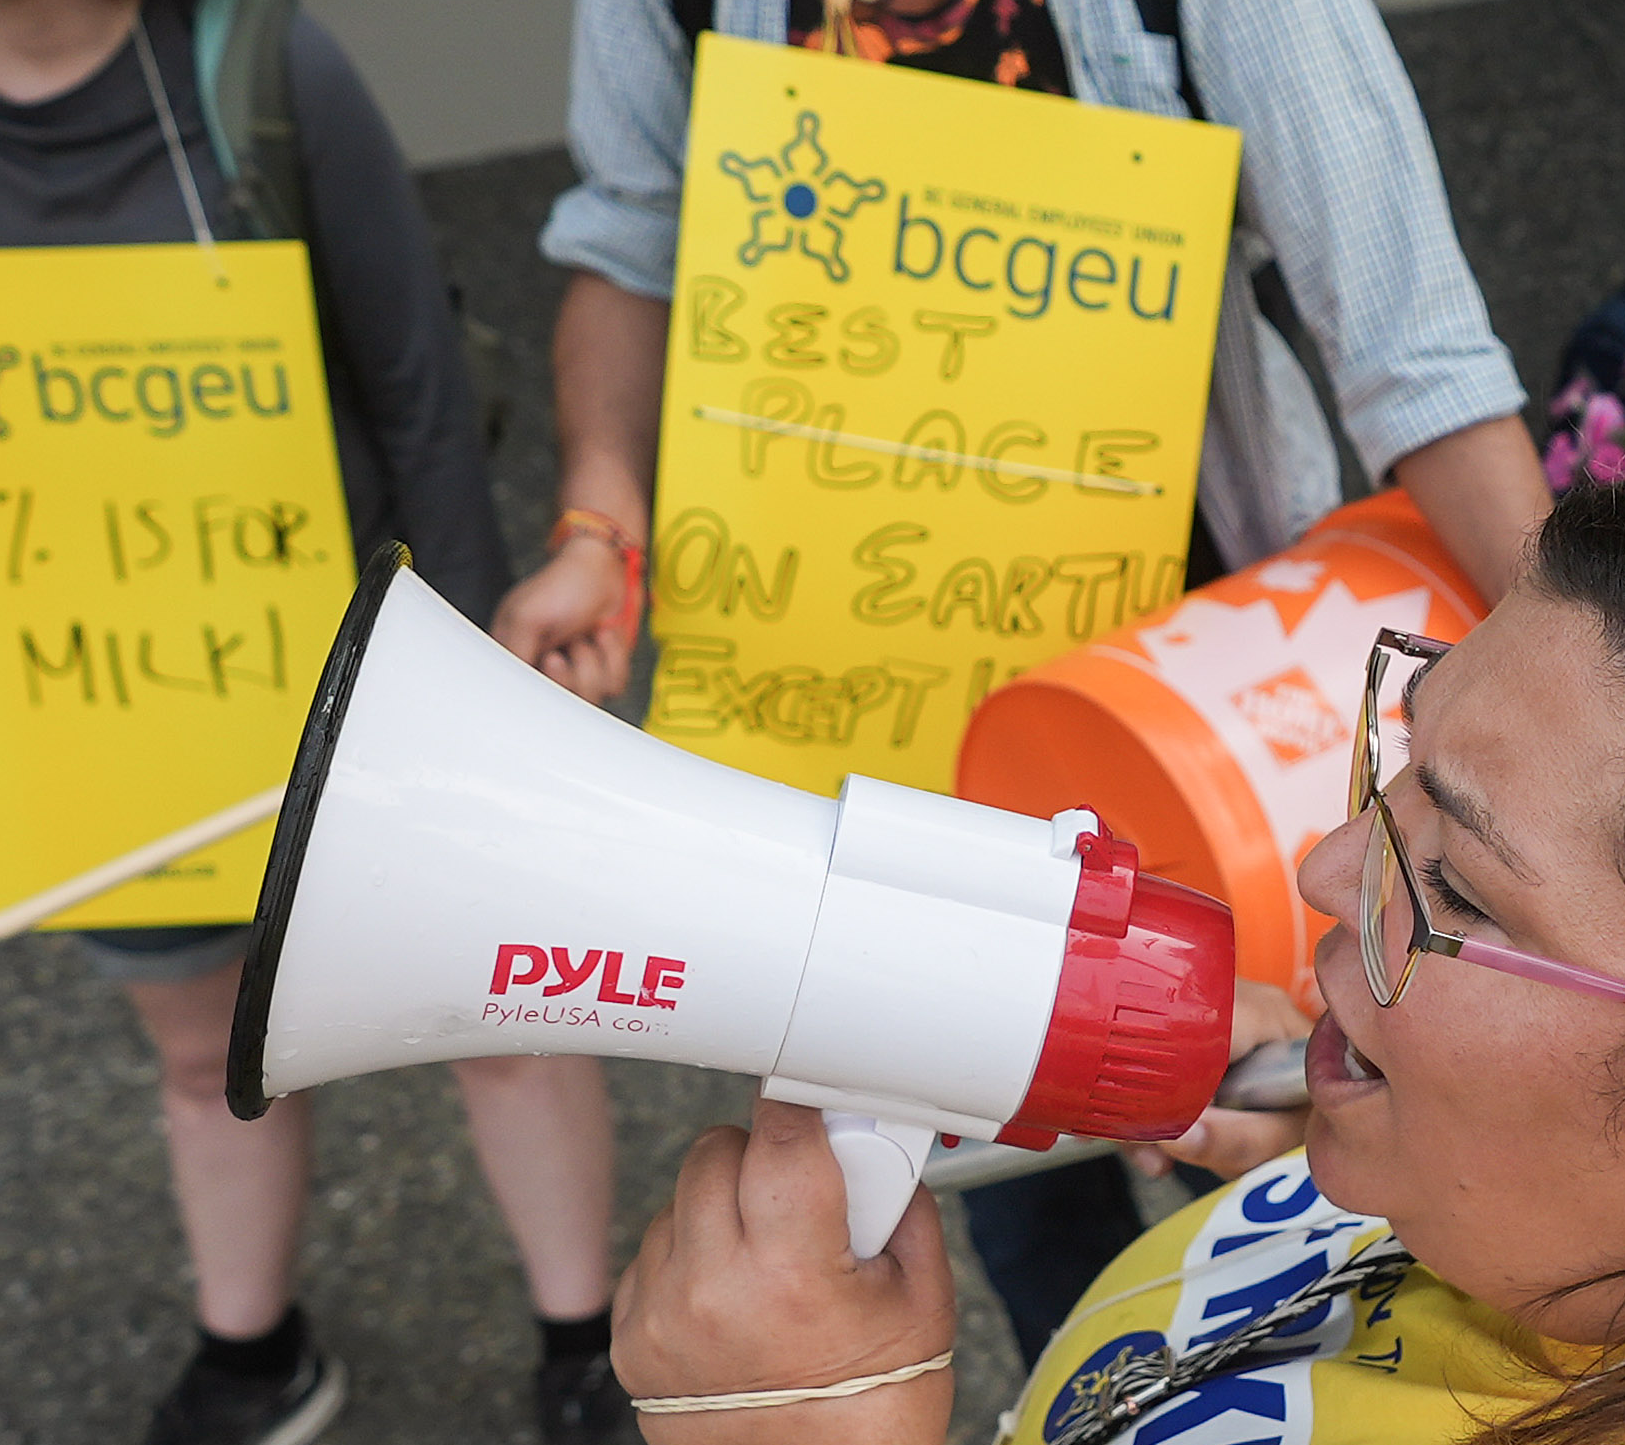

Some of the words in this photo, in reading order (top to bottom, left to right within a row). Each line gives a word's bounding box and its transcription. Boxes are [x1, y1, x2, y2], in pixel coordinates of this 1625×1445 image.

[893, 194, 1180, 323] bcgeu
[686, 274, 997, 382] BEST
[31, 354, 293, 438] bcgeu
[738, 376, 1161, 504] PLACE
[103, 498, 176, 584] IS
[651, 506, 802, 622] ON
[488, 943, 687, 1011] PYLE
